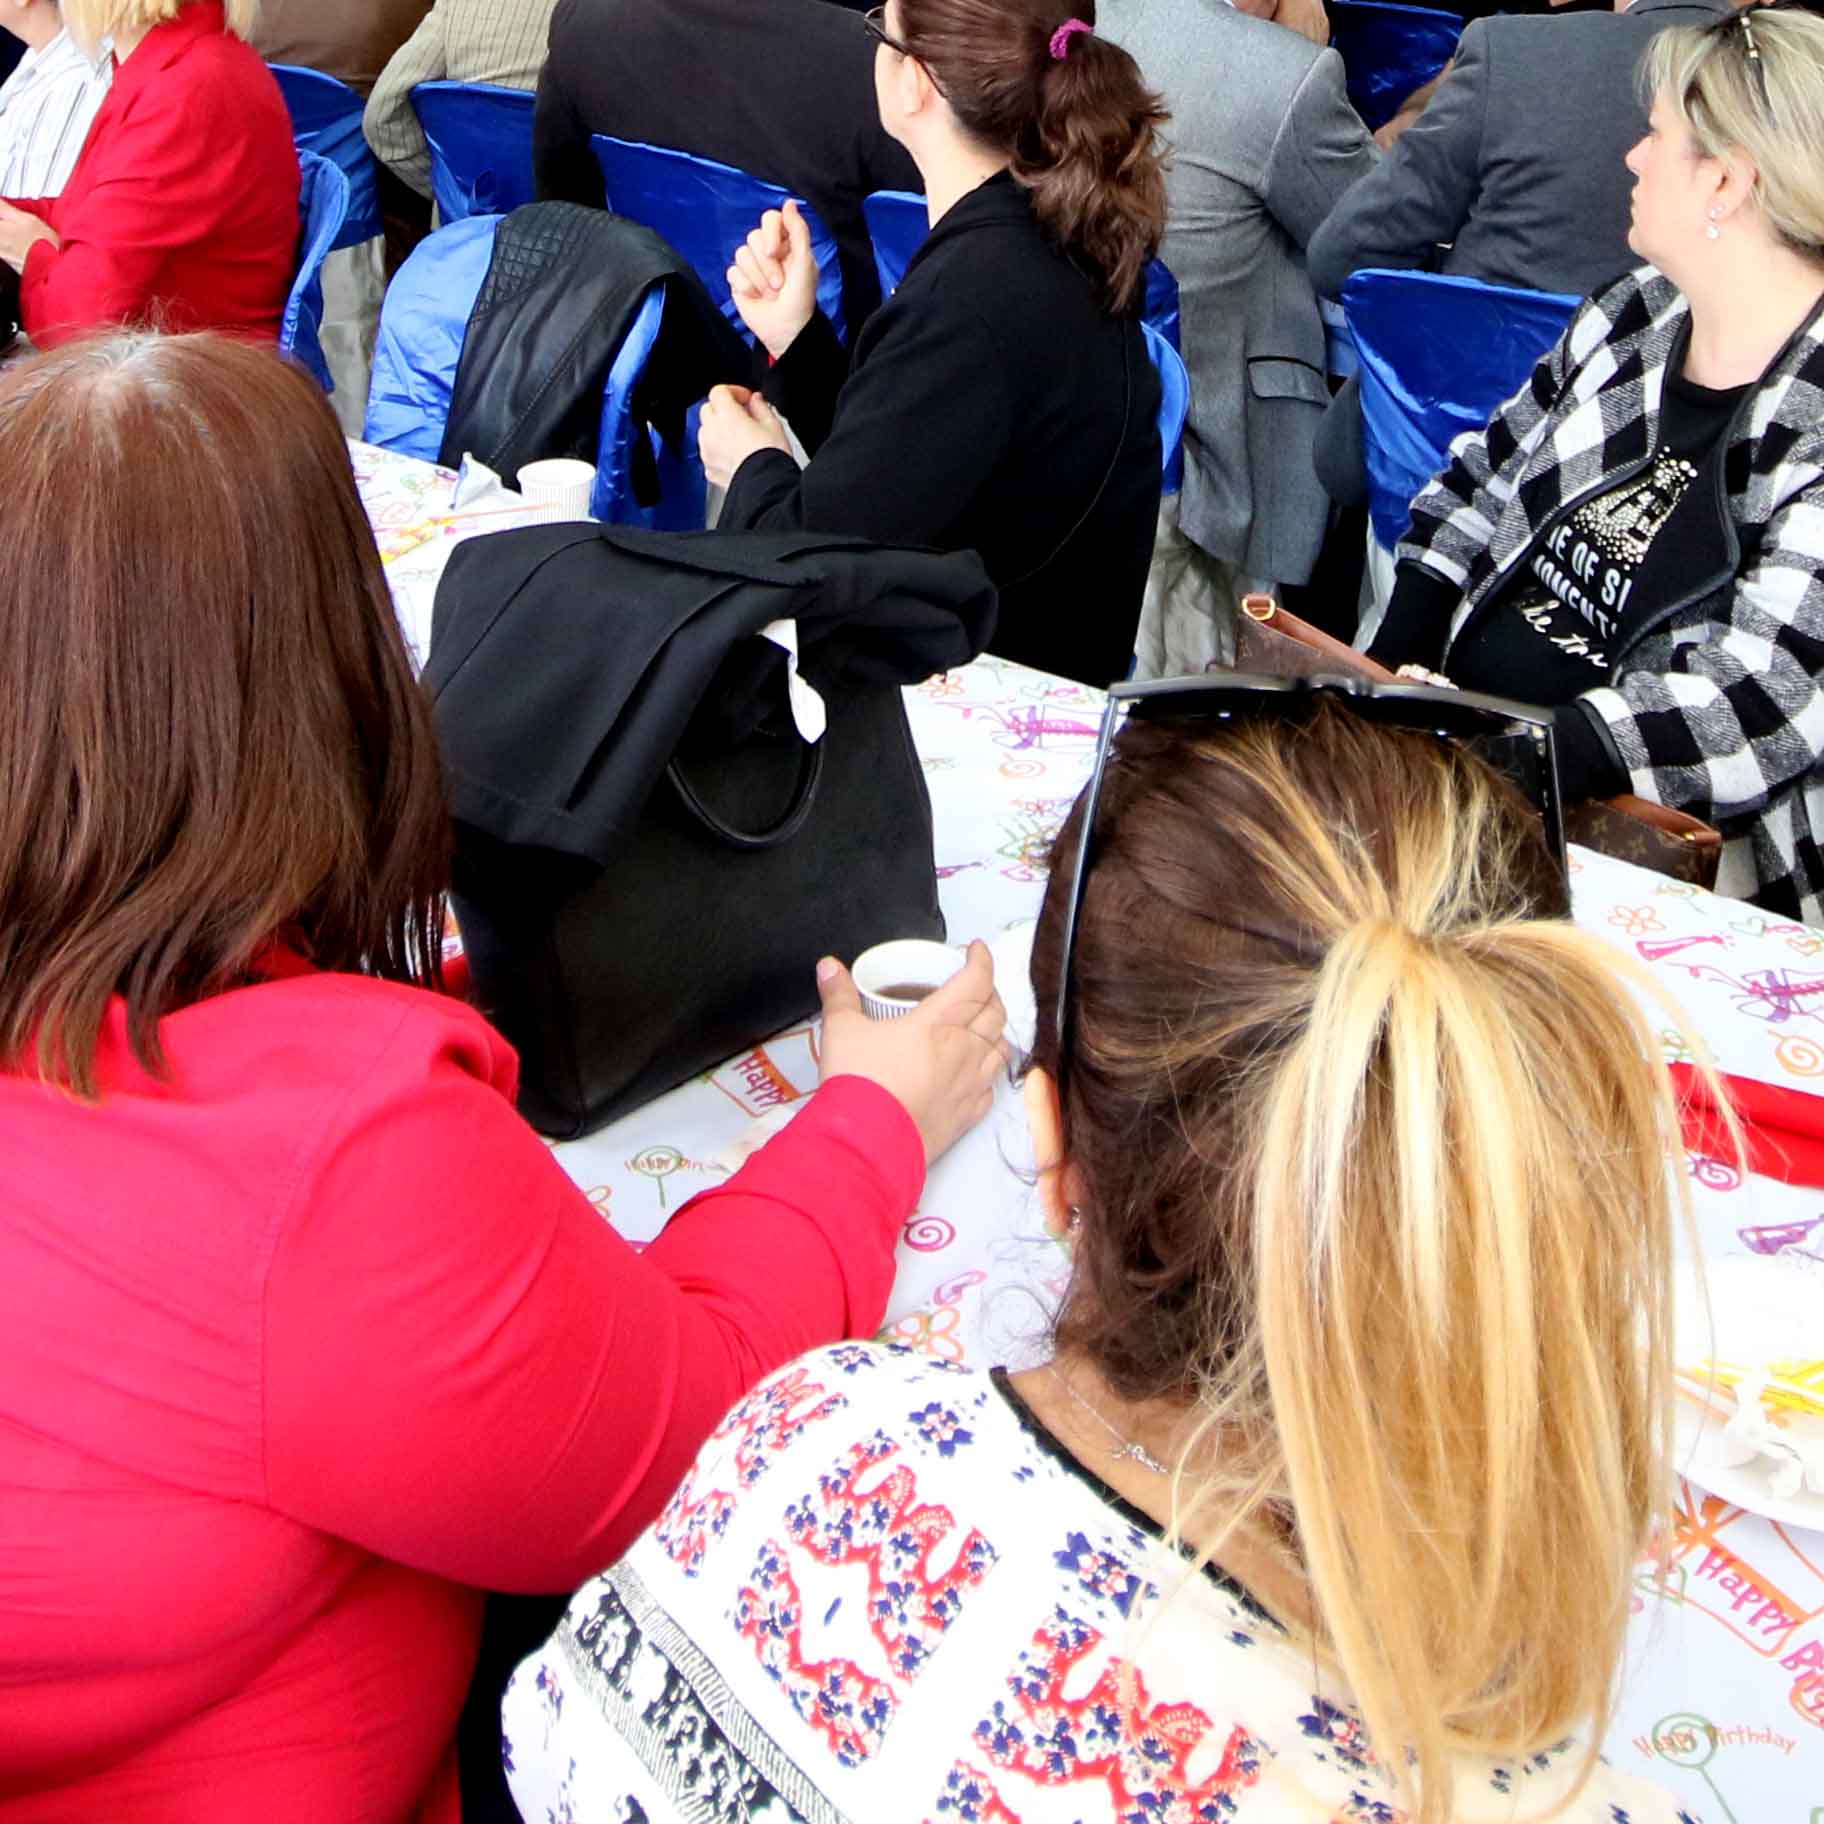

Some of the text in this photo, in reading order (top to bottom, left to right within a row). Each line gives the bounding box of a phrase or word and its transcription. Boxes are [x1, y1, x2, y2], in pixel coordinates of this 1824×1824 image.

[1572, 542, 1600, 584] OF
[732, 1055, 785, 1108] Happy
[1695, 1547, 1798, 1635] Happy
